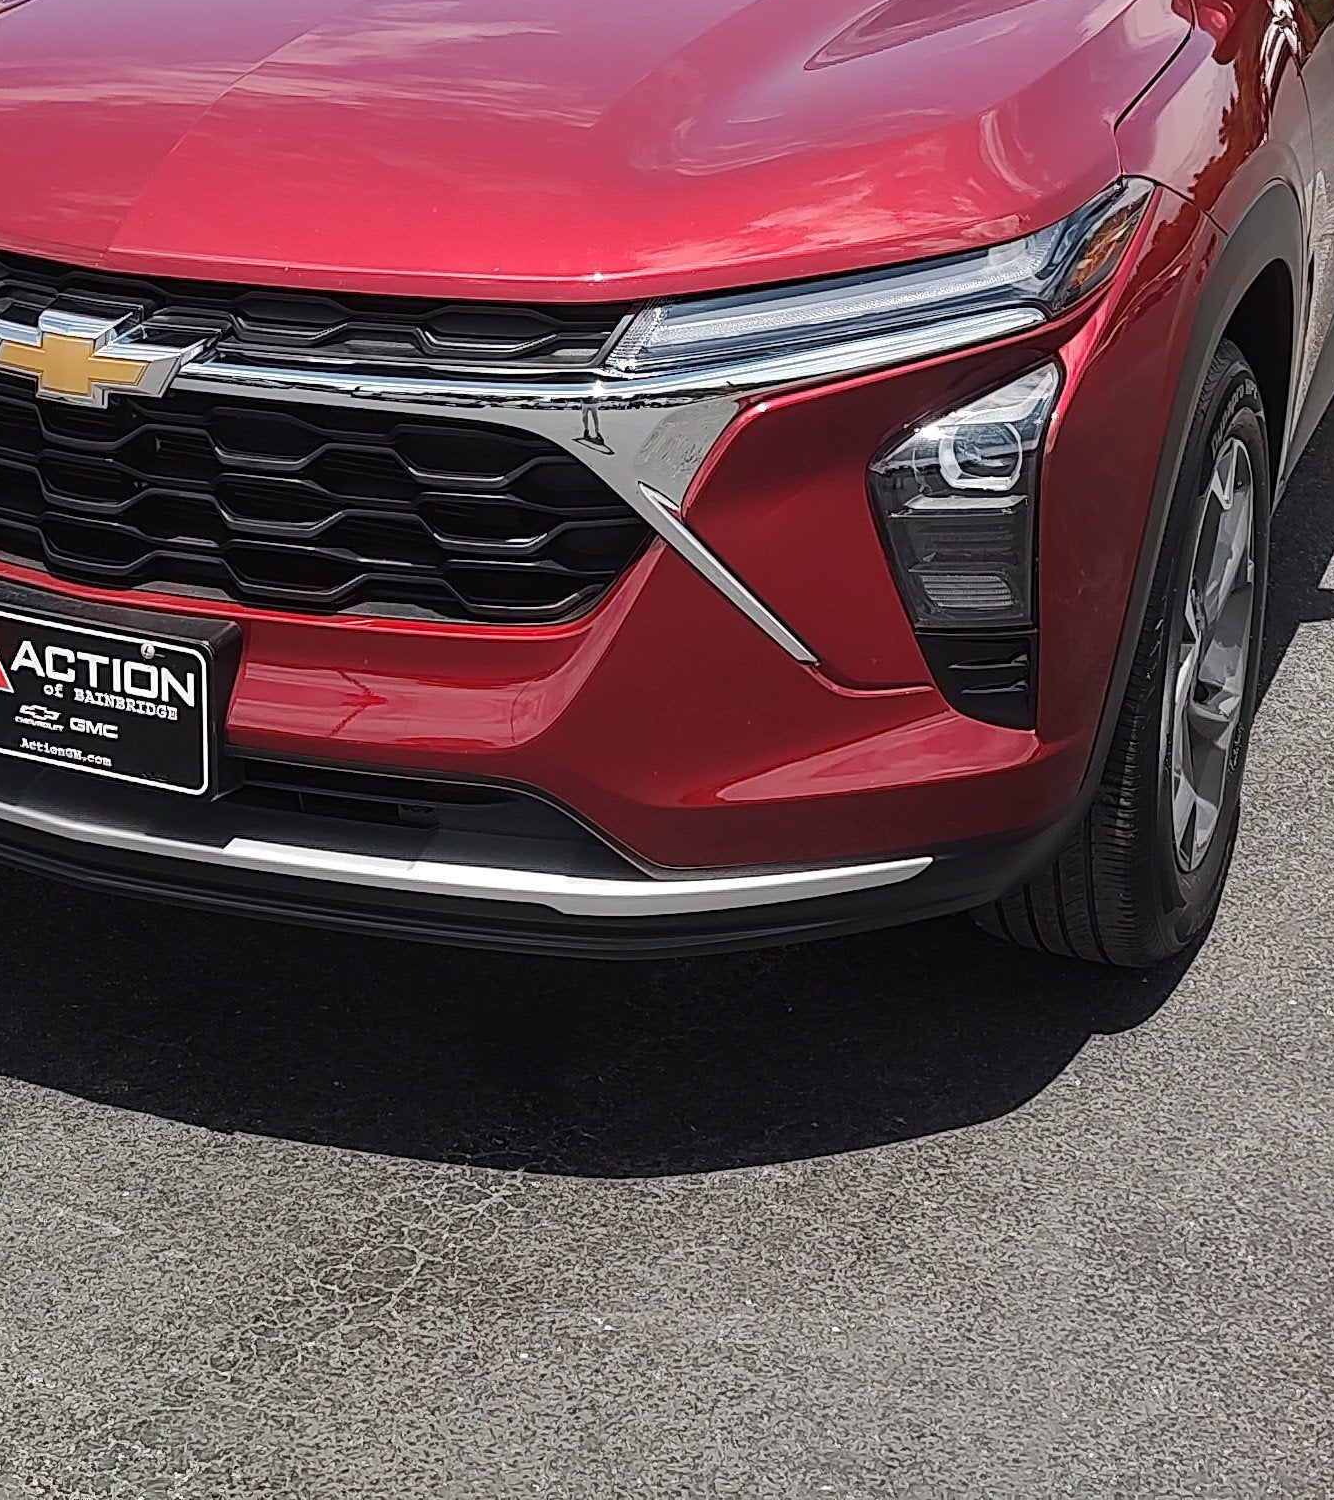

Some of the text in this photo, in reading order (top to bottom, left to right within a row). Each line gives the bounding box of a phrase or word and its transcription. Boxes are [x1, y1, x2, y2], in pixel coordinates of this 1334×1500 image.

[10, 640, 195, 707] ACTION
[43, 683, 179, 722] of BAINBRIDGE
[69, 717, 119, 739] GMC
